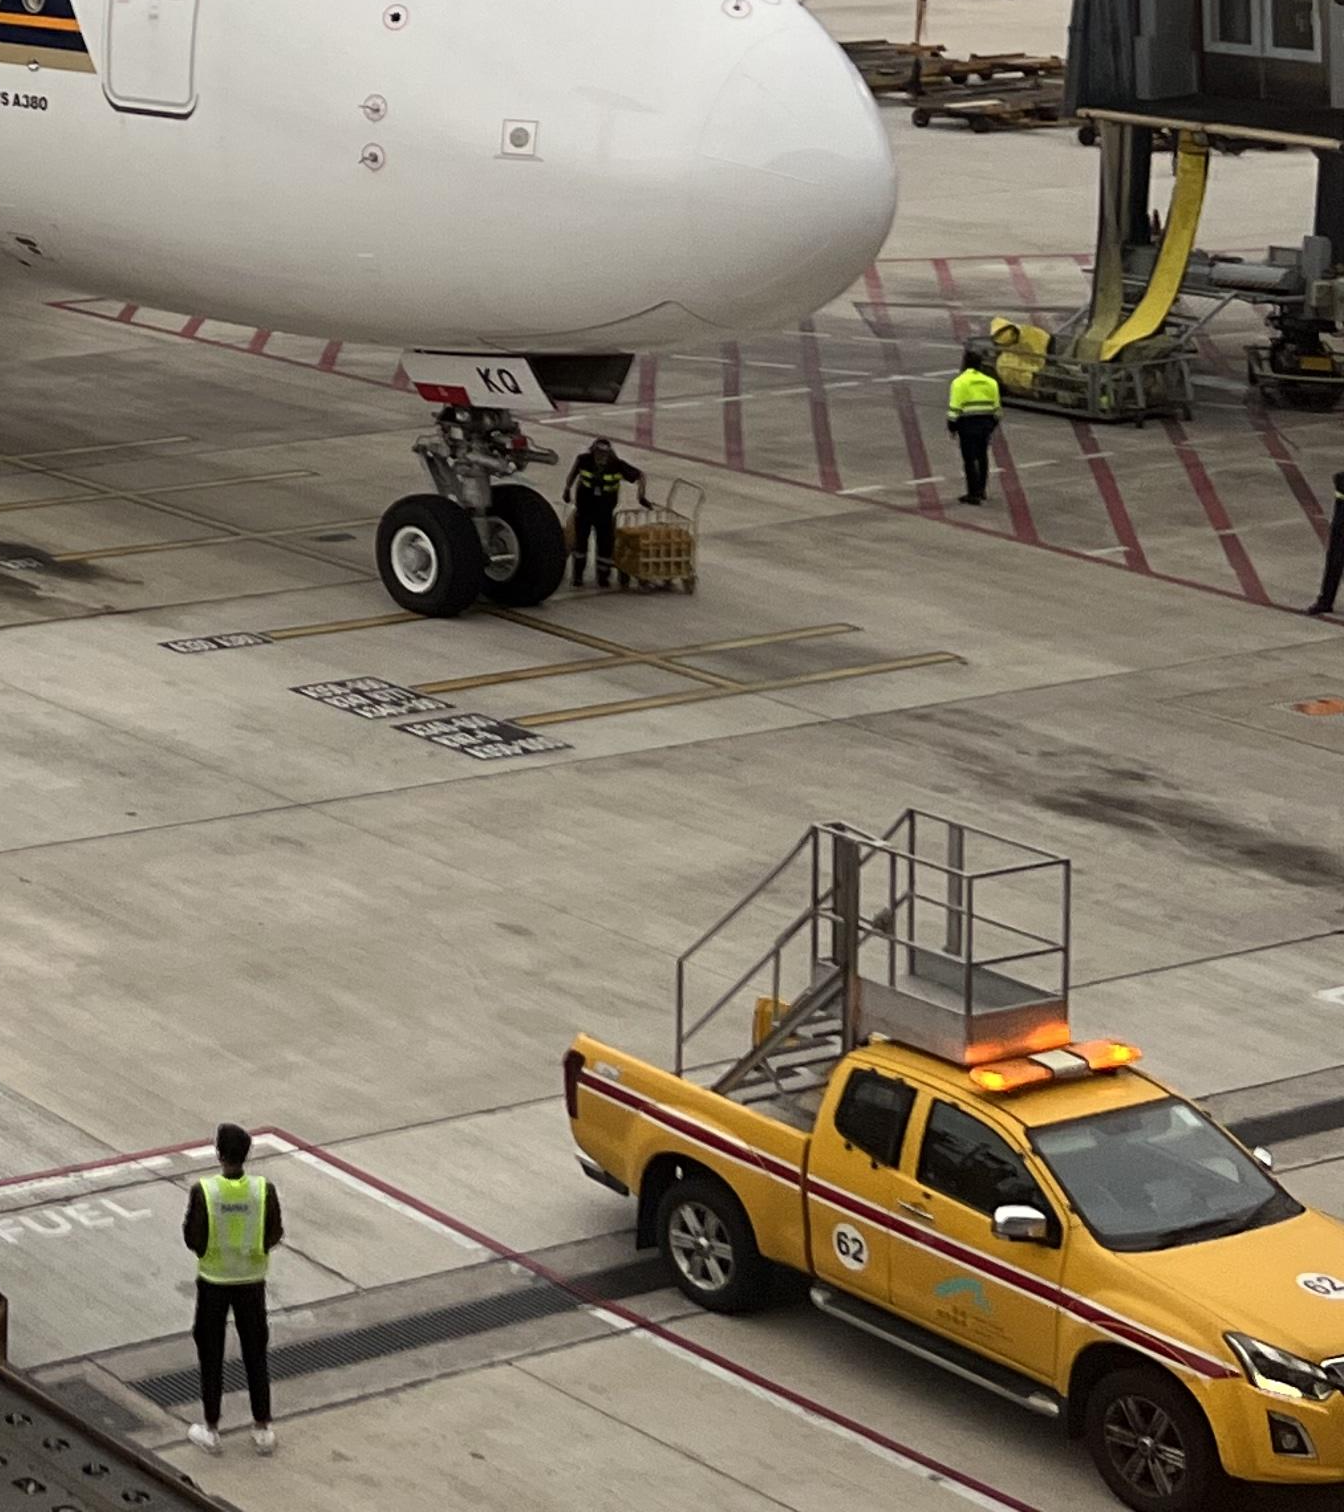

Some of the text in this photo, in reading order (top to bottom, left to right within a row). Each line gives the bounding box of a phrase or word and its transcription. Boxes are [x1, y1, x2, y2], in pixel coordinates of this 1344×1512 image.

[12, 93, 48, 111] A380
[476, 366, 523, 395] KQ
[836, 1231, 864, 1264] 62
[1303, 1276, 1344, 1295] 62
